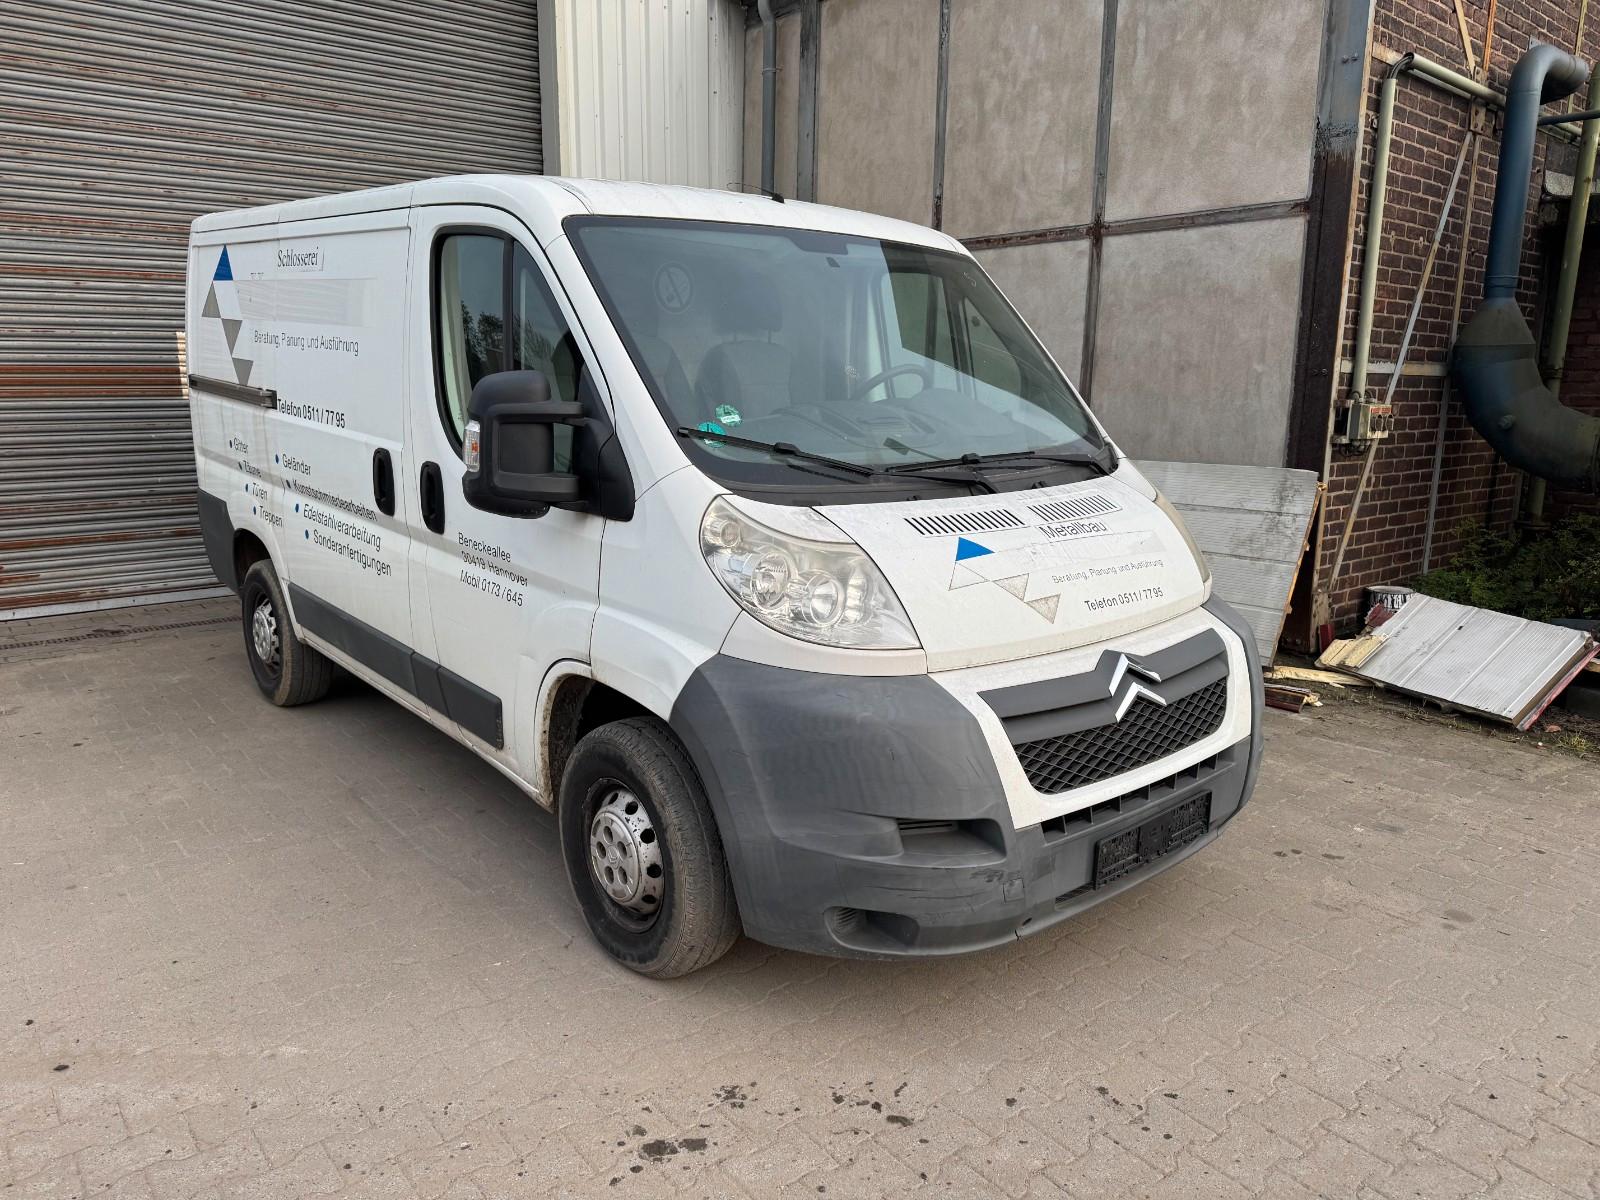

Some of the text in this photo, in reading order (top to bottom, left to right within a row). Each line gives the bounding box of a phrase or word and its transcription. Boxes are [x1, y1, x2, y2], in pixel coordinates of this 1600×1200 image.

[277, 246, 319, 268] Schlosserei
[281, 332, 305, 351] Planung
[306, 335, 319, 349] und
[320, 335, 359, 357] Ausführung
[277, 398, 302, 418] Telefon
[282, 453, 312, 476] Geländer
[252, 482, 268, 501] Türen
[259, 505, 283, 528] Treppen
[303, 503, 381, 553] Edelstahlverarbeitung
[1038, 519, 1108, 539] Metallbau
[313, 529, 392, 577] Sonderanfertigungen
[458, 532, 511, 563] Beneckeallee
[487, 560, 528, 588] Hannover
[1089, 564, 1118, 579] Planung
[1130, 557, 1165, 572] Ausführung
[459, 569, 481, 590] Mobil
[481, 578, 501, 598] 0173
[506, 588, 524, 607] 645
[1084, 597, 1118, 612] Telefon
